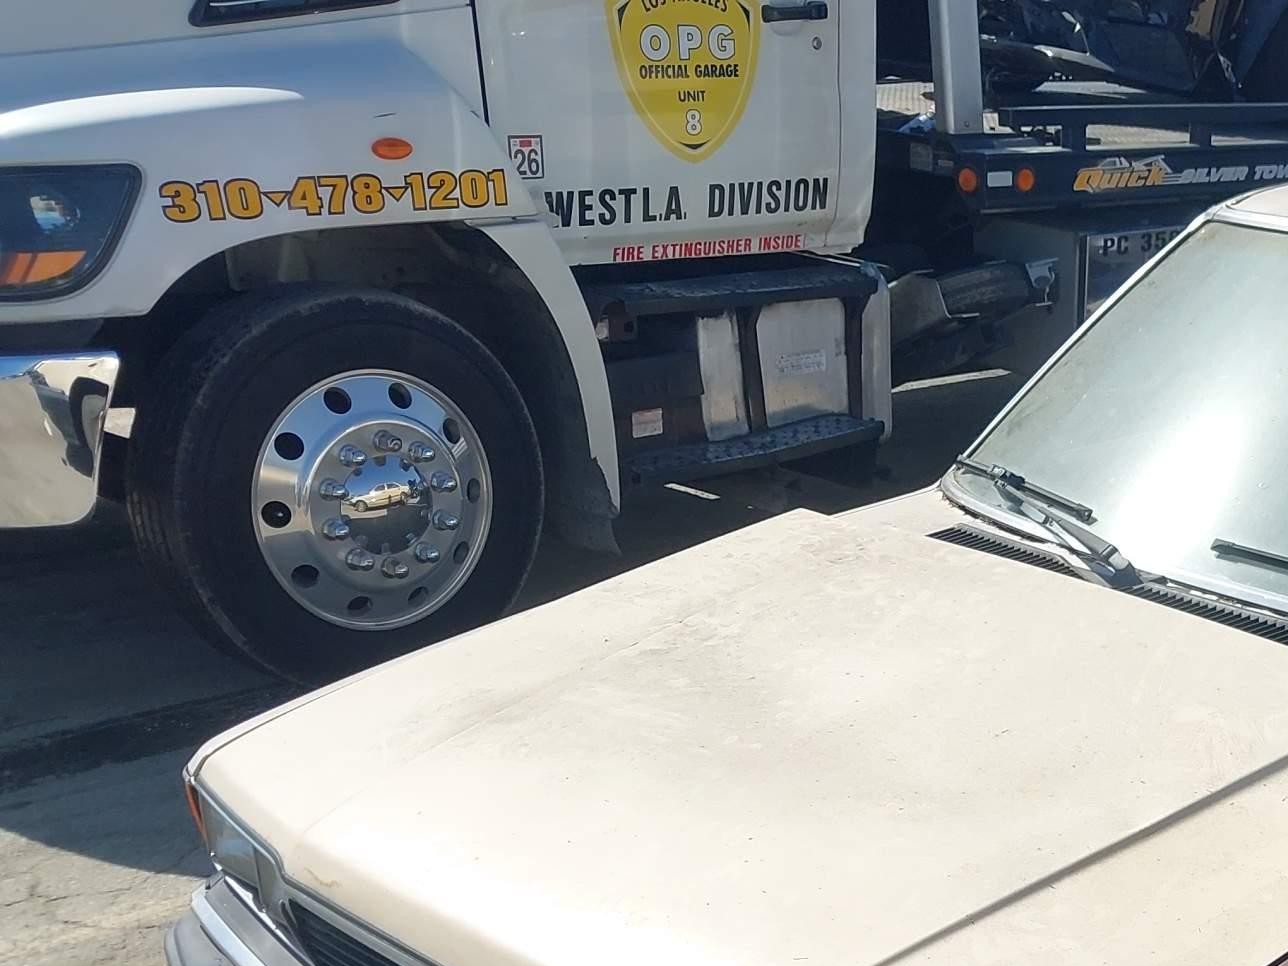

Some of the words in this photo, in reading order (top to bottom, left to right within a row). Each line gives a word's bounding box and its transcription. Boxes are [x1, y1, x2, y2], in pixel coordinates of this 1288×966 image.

[640, 24, 735, 61] OPG
[639, 64, 689, 80] OFFICIAL
[694, 63, 739, 79] GARAGE
[678, 90, 706, 103] UNIT
[685, 108, 702, 136] 8
[513, 148, 540, 176] 26
[1179, 166, 1249, 185] SILVER
[708, 177, 829, 218] DIVISION
[612, 245, 644, 262] FIRE
[651, 237, 752, 260] EXTINGUISHER
[758, 233, 802, 251] INSIDE
[1102, 235, 1129, 257] PC
